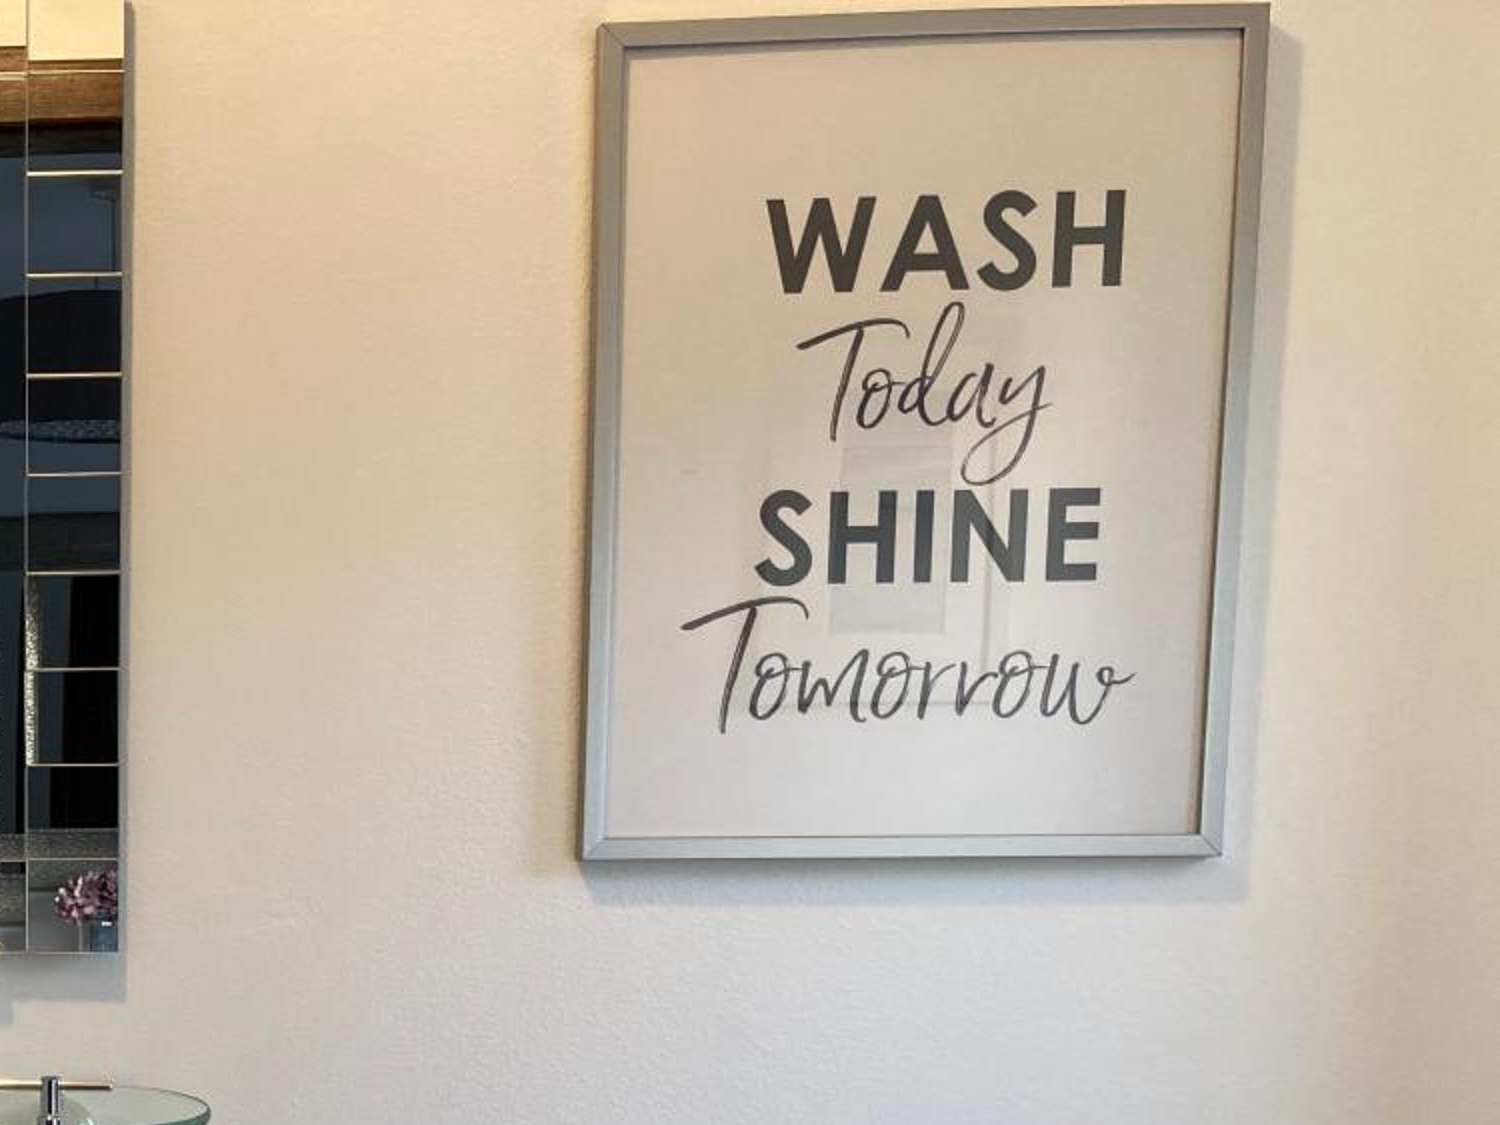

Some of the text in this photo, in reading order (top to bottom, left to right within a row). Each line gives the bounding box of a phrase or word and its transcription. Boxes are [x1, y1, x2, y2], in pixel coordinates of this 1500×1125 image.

[765, 189, 1127, 295] WASH
[795, 300, 1054, 487] Today
[753, 487, 1102, 587] SHINE
[680, 595, 1137, 736] Tomorrow
